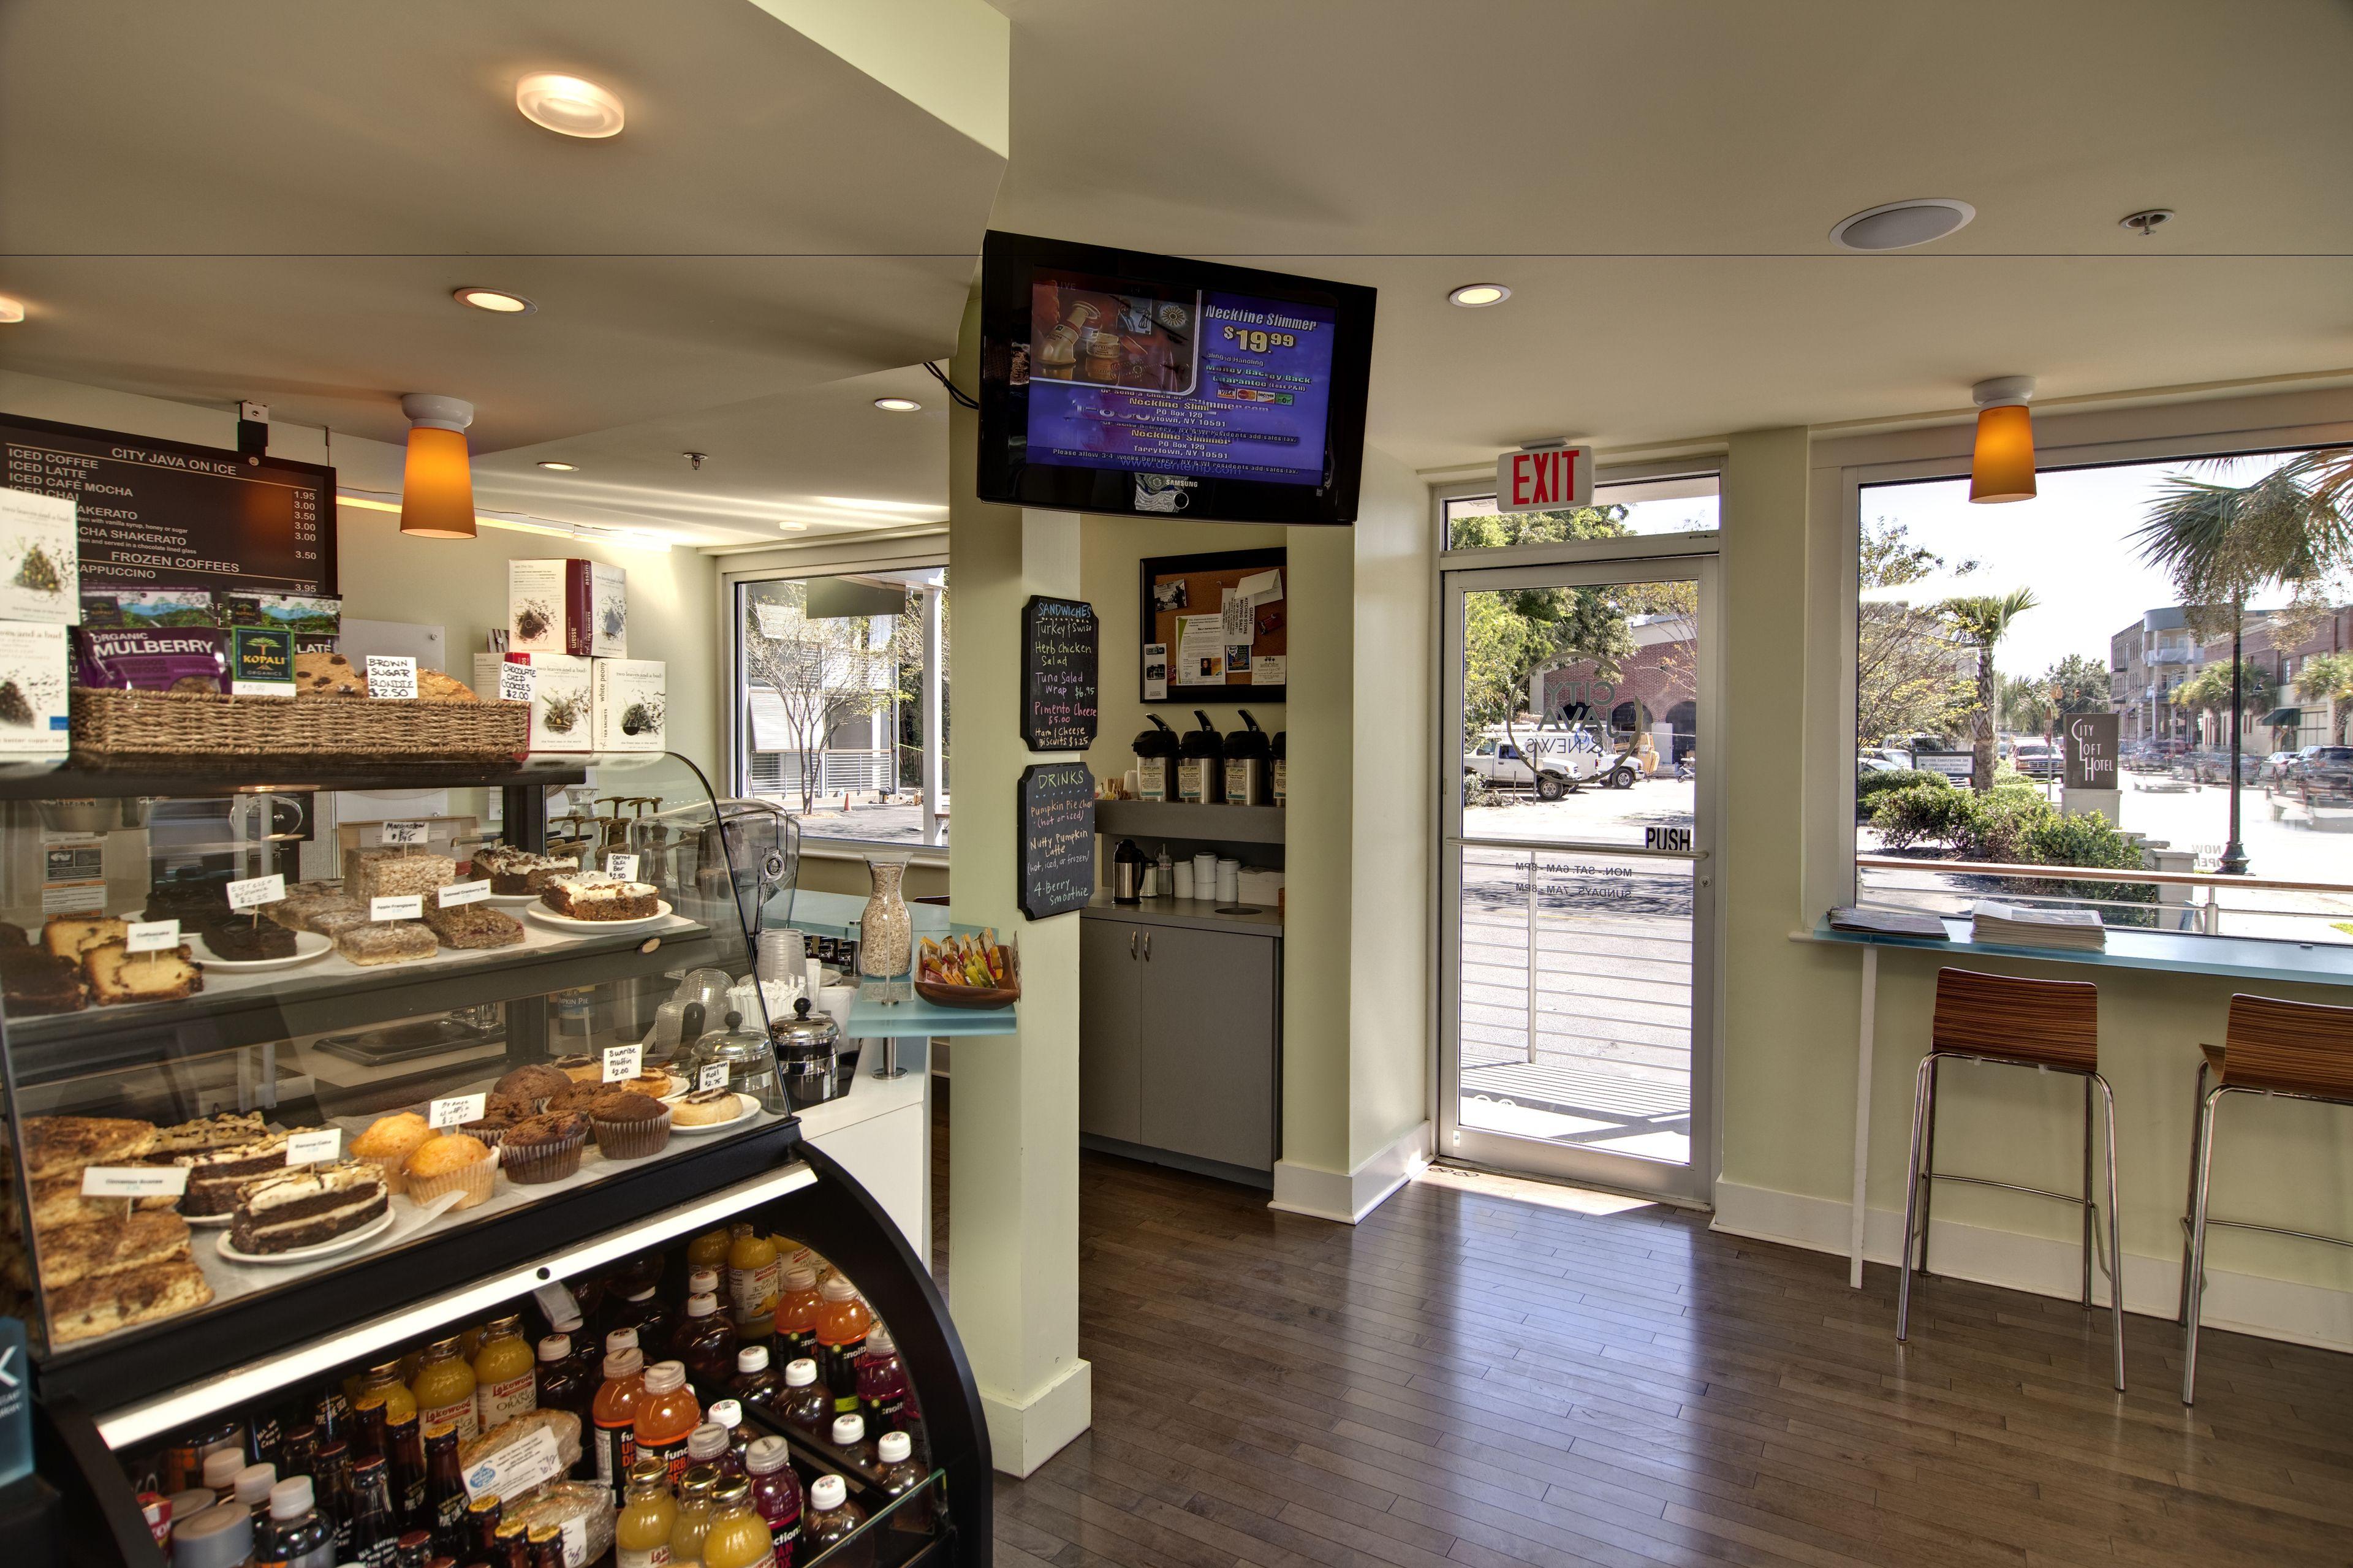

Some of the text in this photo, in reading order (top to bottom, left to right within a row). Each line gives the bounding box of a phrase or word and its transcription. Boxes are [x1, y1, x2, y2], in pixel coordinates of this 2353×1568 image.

[1206, 305, 1317, 330] Neckline Slimmer
[1224, 326, 1294, 354] $19.99
[1199, 419, 1226, 428] 10591
[9, 448, 99, 469] ICED COFFEE
[112, 448, 237, 475] CITY JAVA ON ICE
[9, 460, 88, 479] ICED LATTE
[9, 472, 134, 497] ICED CAFÉ MOCHA
[1165, 479, 1198, 488] SAMSUNG
[1513, 450, 1579, 506] EXIT
[294, 491, 316, 501] 1.95
[294, 501, 316, 511] 3.00
[295, 511, 316, 521] 3.50
[105, 518, 125, 527] vanilla
[126, 522, 145, 531] syrup,
[145, 524, 163, 532] honey
[295, 521, 316, 532] 3.00
[111, 529, 186, 546] SHAKERATO
[295, 532, 317, 542] 3.00
[138, 542, 165, 551] chocolate
[112, 551, 240, 573] FROZEN COFFEES
[295, 550, 317, 561] 3.50
[79, 564, 156, 579] APPUCCINO
[295, 583, 317, 593] 3.95
[1038, 602, 1092, 618] SANDWICHES
[1036, 619, 1065, 638] Turkey
[93, 632, 148, 643] ORGANIC
[93, 639, 214, 658] MULBERRY
[1036, 641, 1055, 654] Herb
[243, 654, 285, 665] KOPALI
[368, 658, 407, 667] BROWN
[1042, 655, 1067, 667] Salad
[371, 668, 411, 678] SUGAR
[503, 664, 536, 678] CHOCOLATE
[507, 673, 525, 683] CHIP
[369, 678, 414, 688] BLONDIE
[501, 679, 531, 692] COOKIES
[1036, 672, 1083, 686] Tuna Salad
[368, 687, 409, 697] $2.50
[506, 689, 529, 700] $2.00
[1075, 686, 1095, 700] $6.95
[1035, 701, 1097, 717] Pimento Cheese
[1048, 716, 1070, 725] $5.00
[1036, 726, 1085, 737] Ham Cheese
[2071, 718, 2094, 741] CITY
[1039, 737, 1067, 747] Biscuits
[2079, 737, 2102, 761] LOFT
[2085, 757, 2113, 781] HOTEL
[1038, 770, 1085, 789] DRINKS
[1031, 799, 1064, 817] Pumpkin
[1066, 800, 1077, 811] Pie
[1037, 817, 1055, 828] (hot
[1066, 809, 1084, 821] iced)
[1030, 829, 1088, 851] Nutty Pumpkin
[1645, 828, 1691, 852] PUSH
[1045, 844, 1066, 857] Latte
[1027, 850, 1089, 876] (hot, iced, or frozen)
[1034, 879, 1070, 897] 4-Berry
[1050, 887, 1089, 906] Smoothie
[612, 1067, 629, 1076] $2.00
[493, 1372, 534, 1397] Lakewood
[496, 1388, 536, 1411] ORANGE
[426, 1397, 471, 1423] Lakewood
